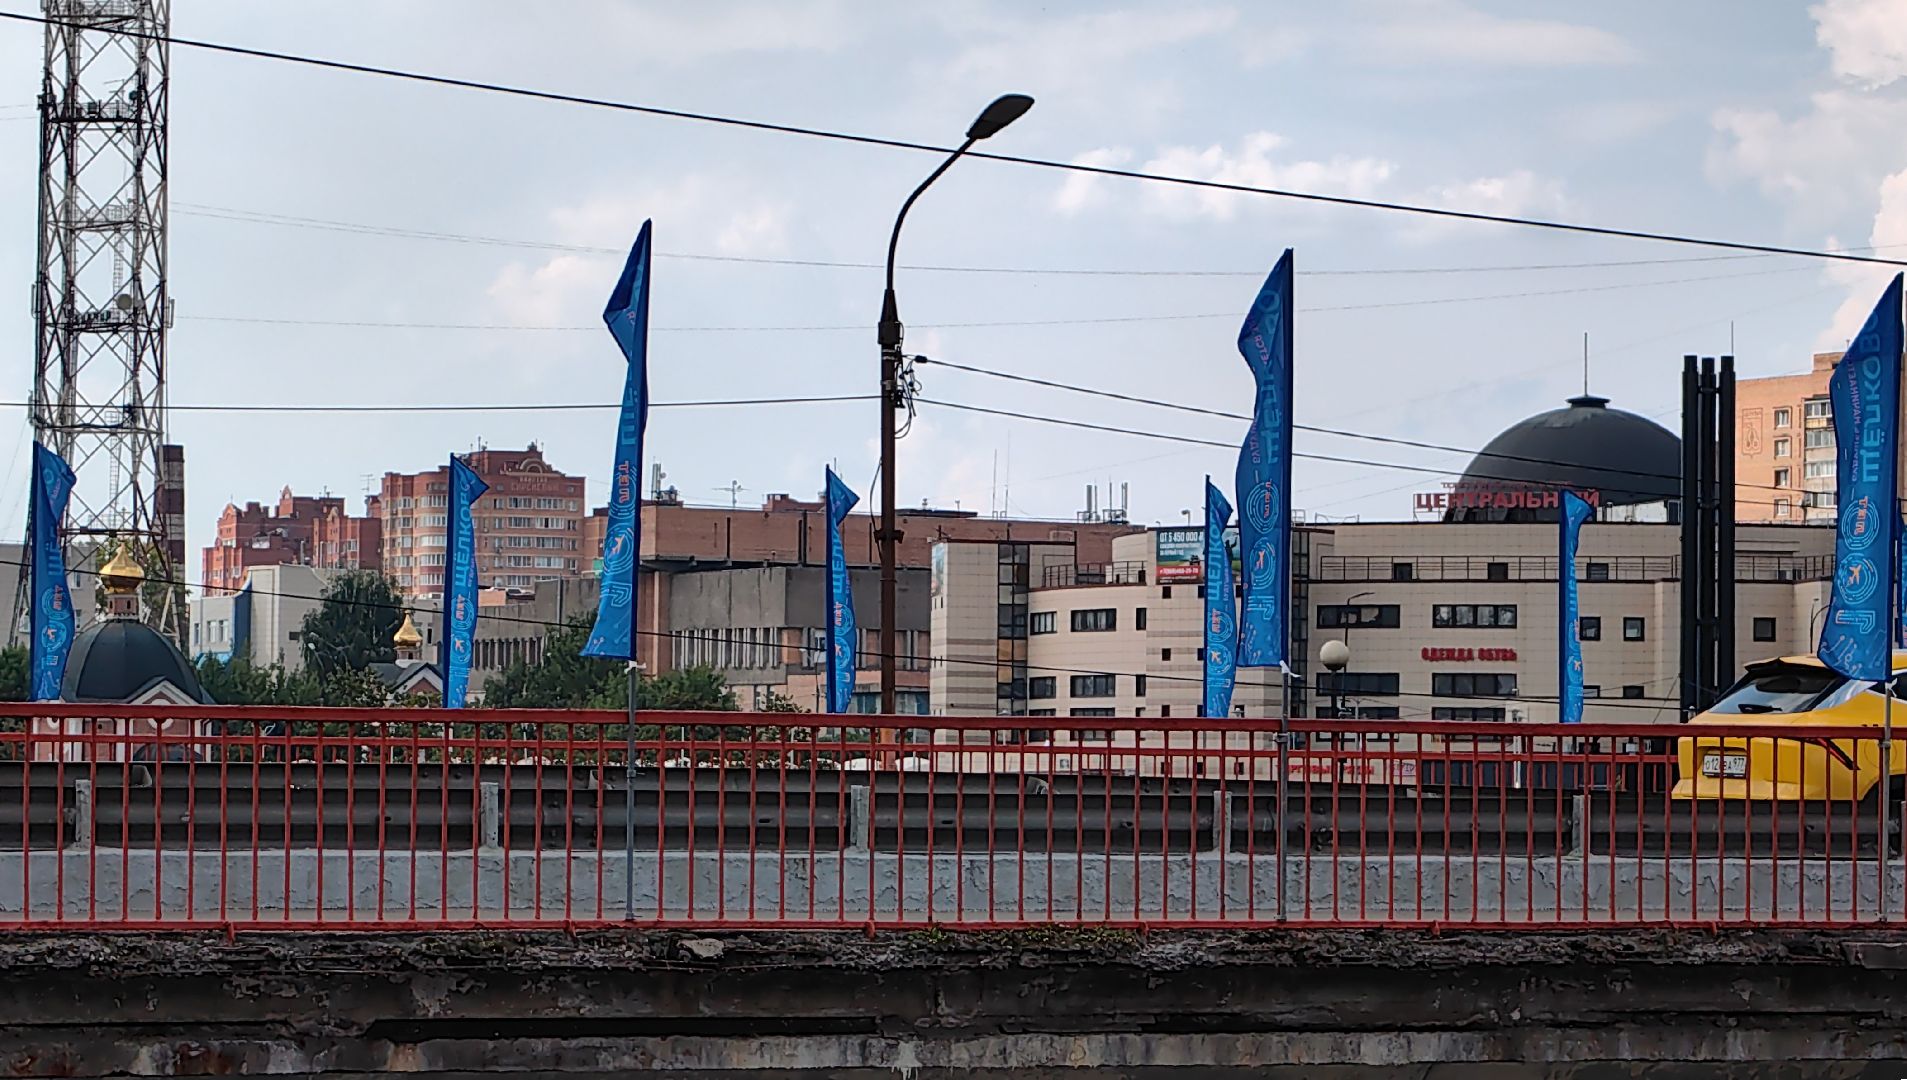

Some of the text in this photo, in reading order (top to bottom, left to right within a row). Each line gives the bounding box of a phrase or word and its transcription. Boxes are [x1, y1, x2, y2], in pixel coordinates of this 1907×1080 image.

[1416, 489, 1600, 512] ЦЕНТРАЛЬНЙ
[1421, 647, 1517, 662] ОДЕЖДА ОБУВЬ
